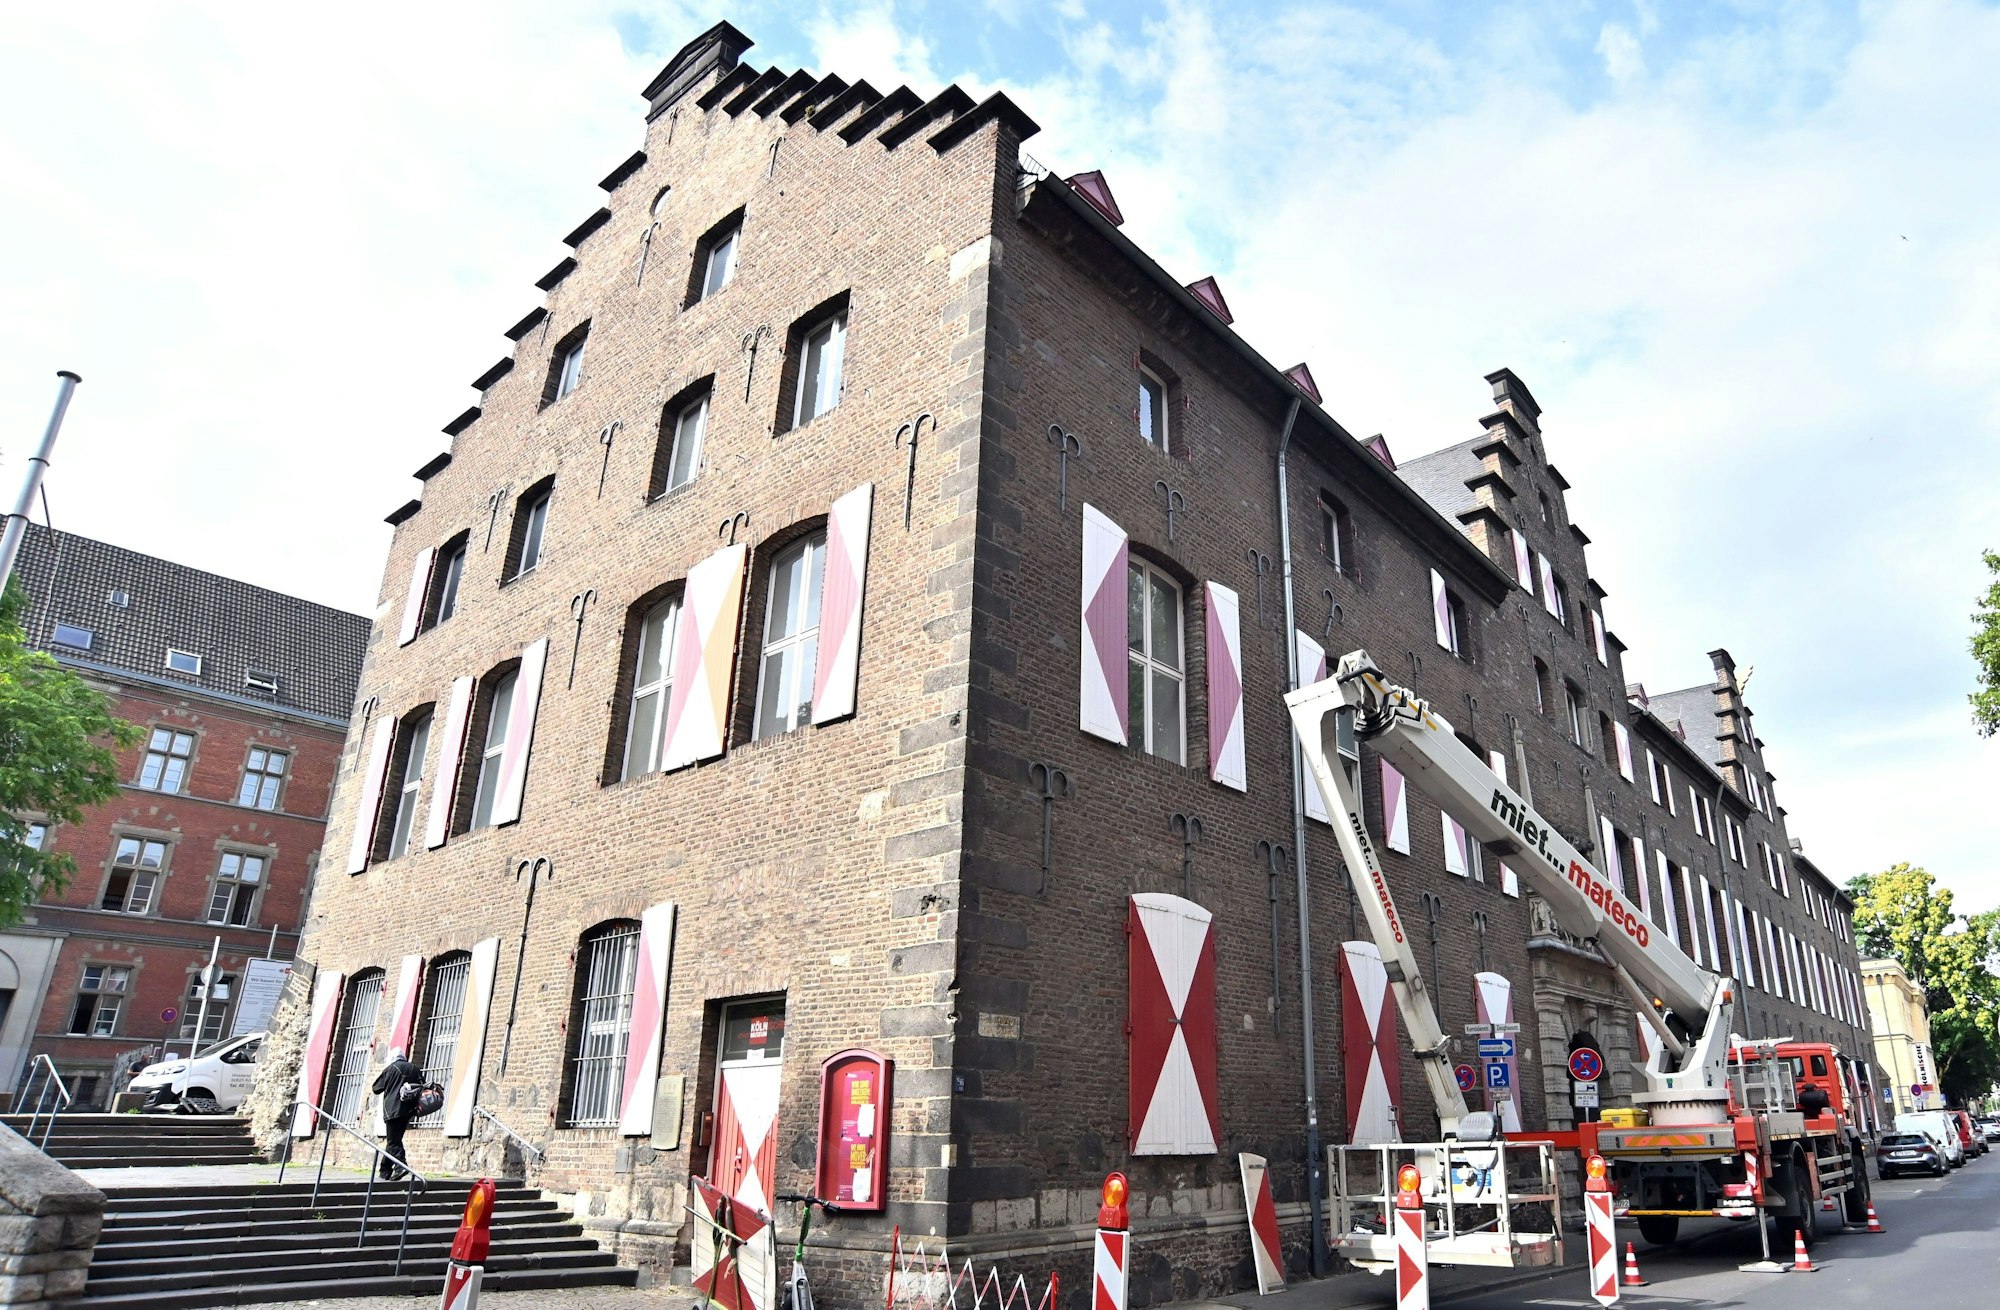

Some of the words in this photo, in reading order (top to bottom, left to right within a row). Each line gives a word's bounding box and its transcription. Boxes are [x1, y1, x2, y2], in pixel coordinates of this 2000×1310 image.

[1372, 871, 1403, 943] mateco
[1567, 859, 1649, 948] mateco
[751, 1020, 768, 1031] KÖLN
[1490, 1066, 1503, 1086] P
